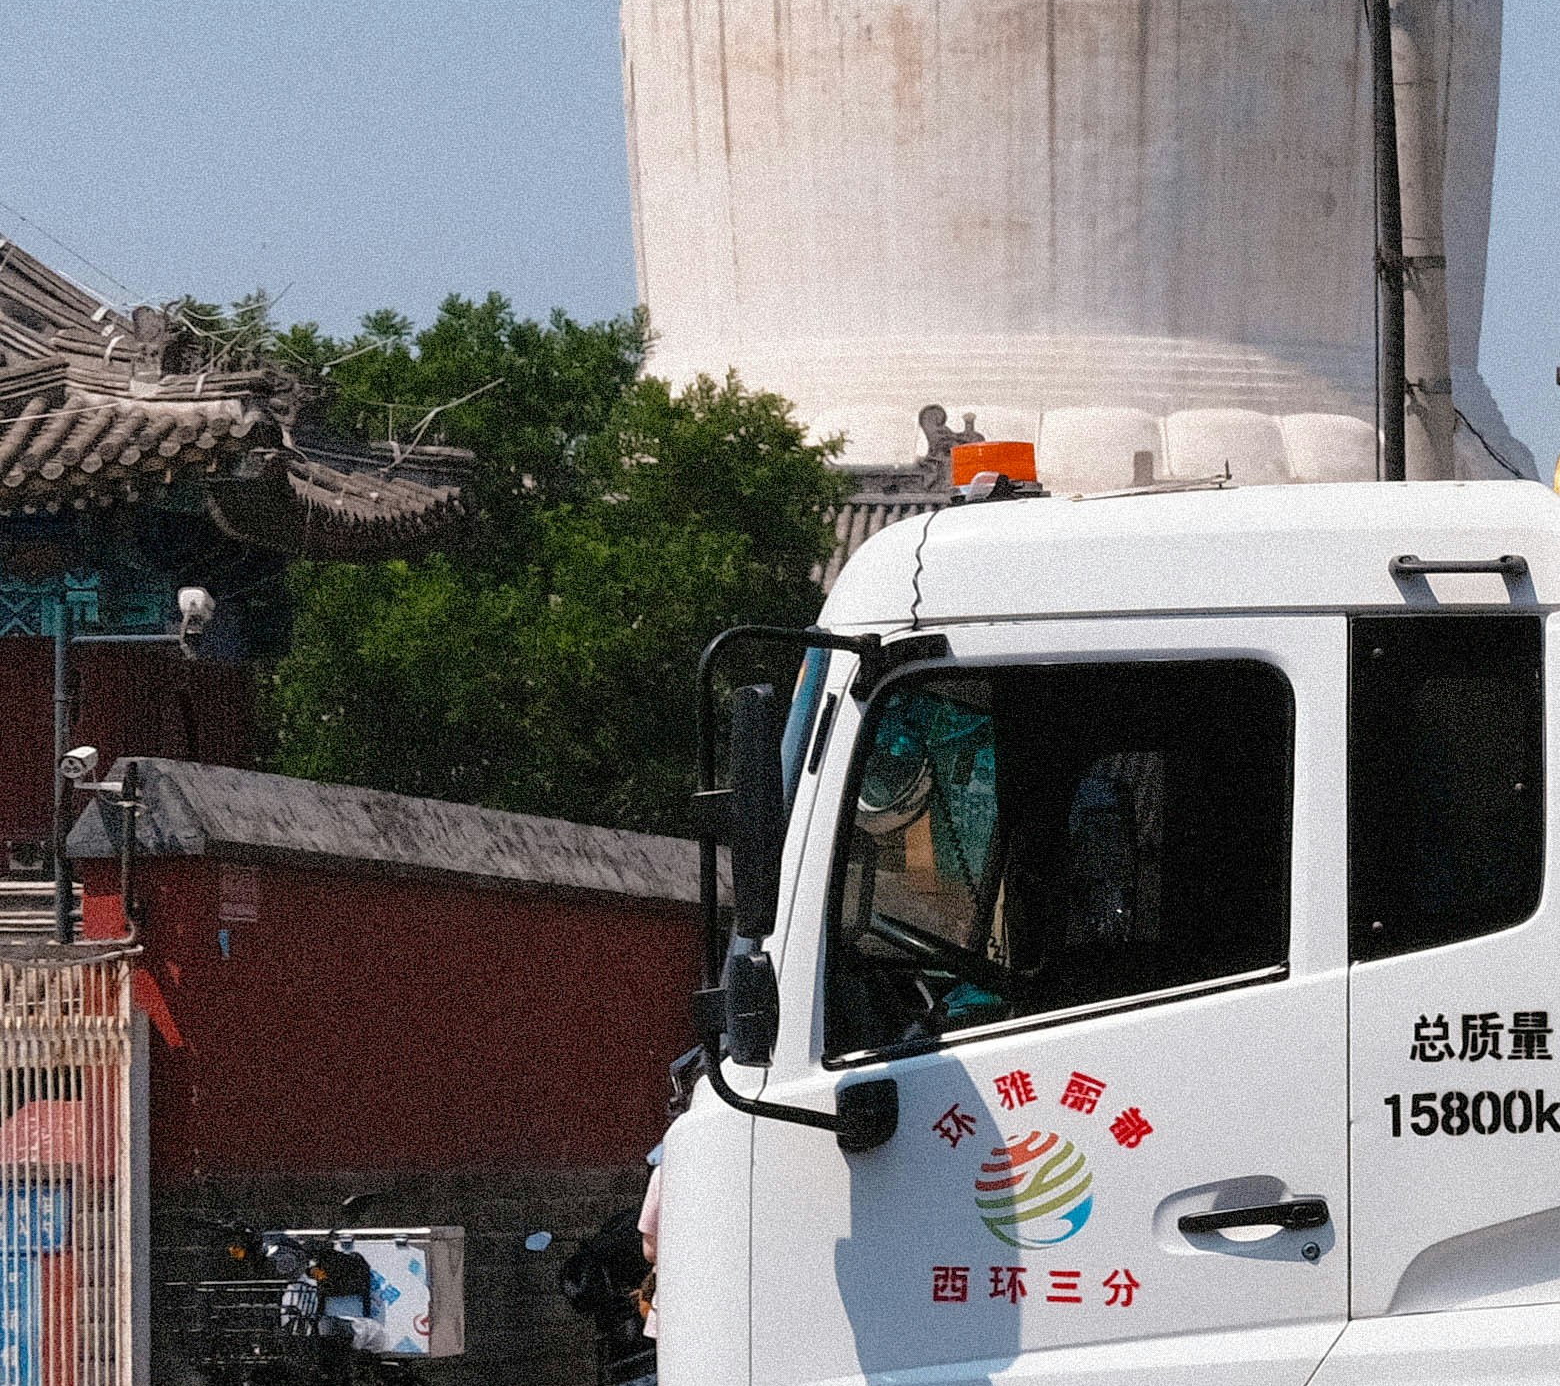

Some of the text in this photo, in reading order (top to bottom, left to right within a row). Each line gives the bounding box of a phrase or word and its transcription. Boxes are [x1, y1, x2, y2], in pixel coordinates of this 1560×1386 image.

[1410, 1011, 1555, 1064] 总质量
[934, 1069, 1154, 1151] 环雅丽都
[931, 1264, 1142, 1309] 西环三分
